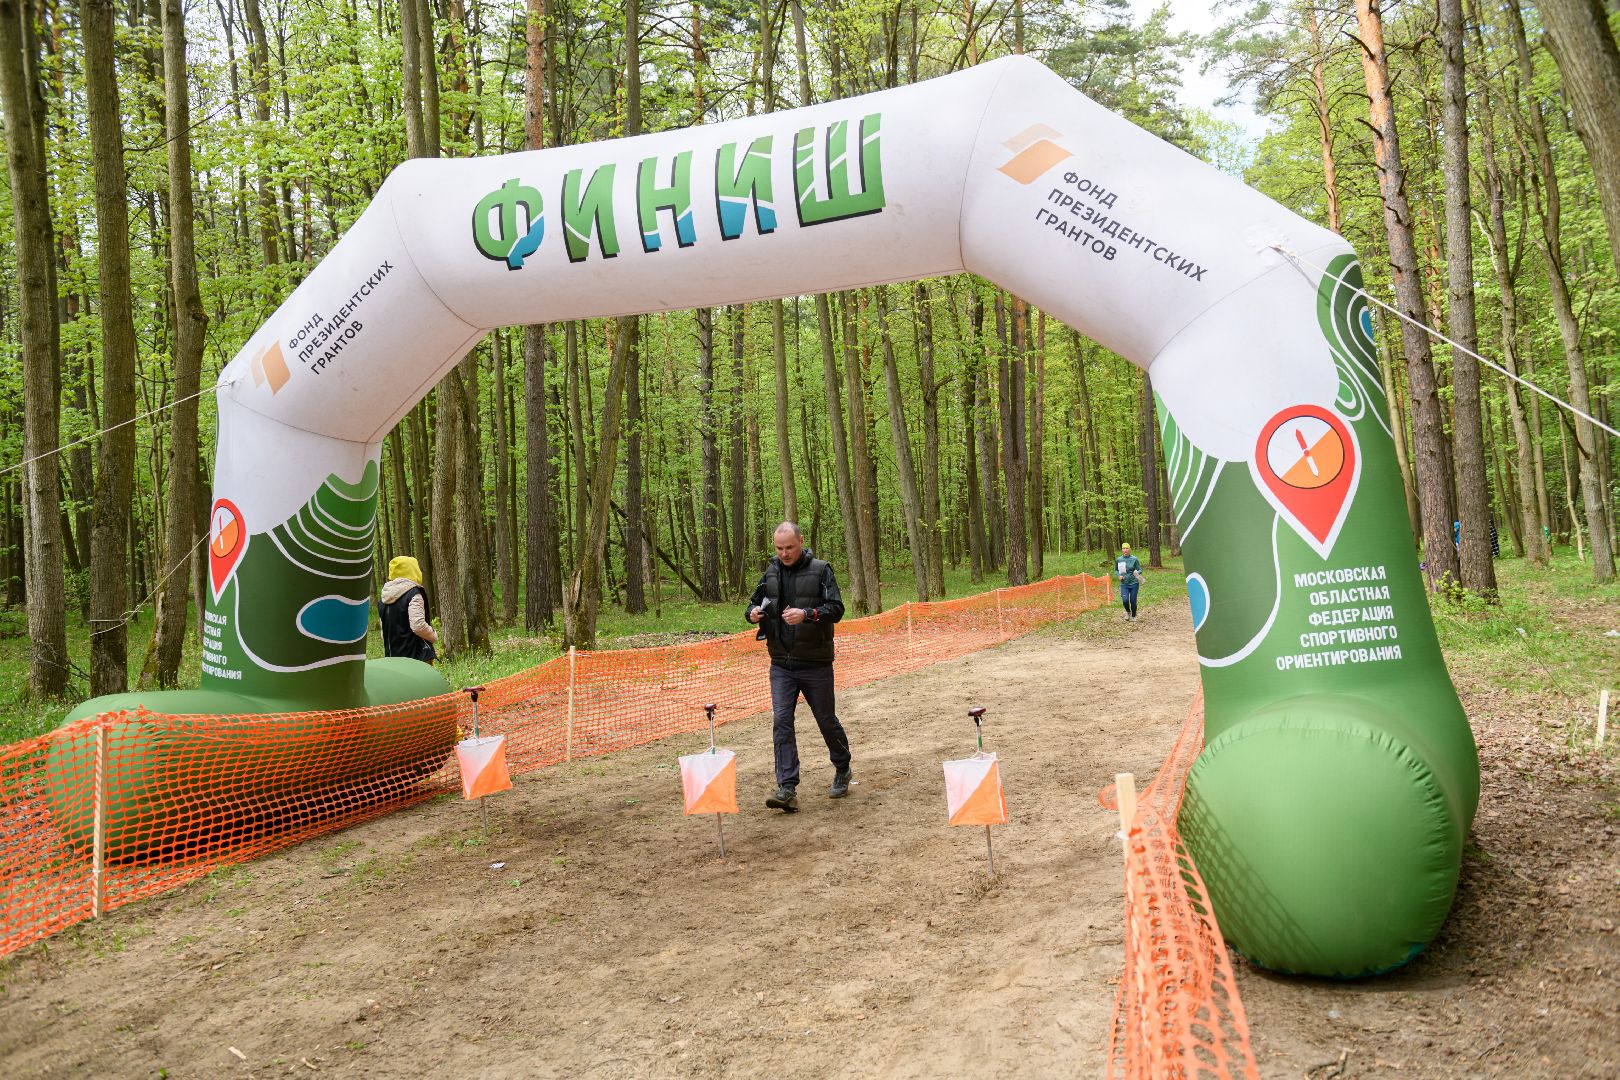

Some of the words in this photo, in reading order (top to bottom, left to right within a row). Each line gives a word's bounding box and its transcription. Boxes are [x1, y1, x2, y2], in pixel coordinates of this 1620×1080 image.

[472, 112, 886, 271] ФИНИШ
[1063, 171, 1118, 210] ФОНД
[1035, 208, 1117, 261] ГРАНТОВ
[1047, 188, 1208, 282] ПРЕЗИДЕНТСКИХ
[298, 260, 394, 363] ПРЕЗИДЕНТСКИХ
[289, 312, 324, 350] ФОНД
[310, 320, 363, 375] ГРАНТОВ
[1294, 565, 1387, 588] МОСКОВСКАЯ
[1309, 586, 1391, 606] ОБЛАСТНАЯ
[1308, 605, 1394, 626] ФЕДЕРАЦИЯ
[1300, 625, 1398, 648] СПОРТИВНОГО
[1276, 645, 1402, 671] ОРИЕНТИРОВАНИЯ
